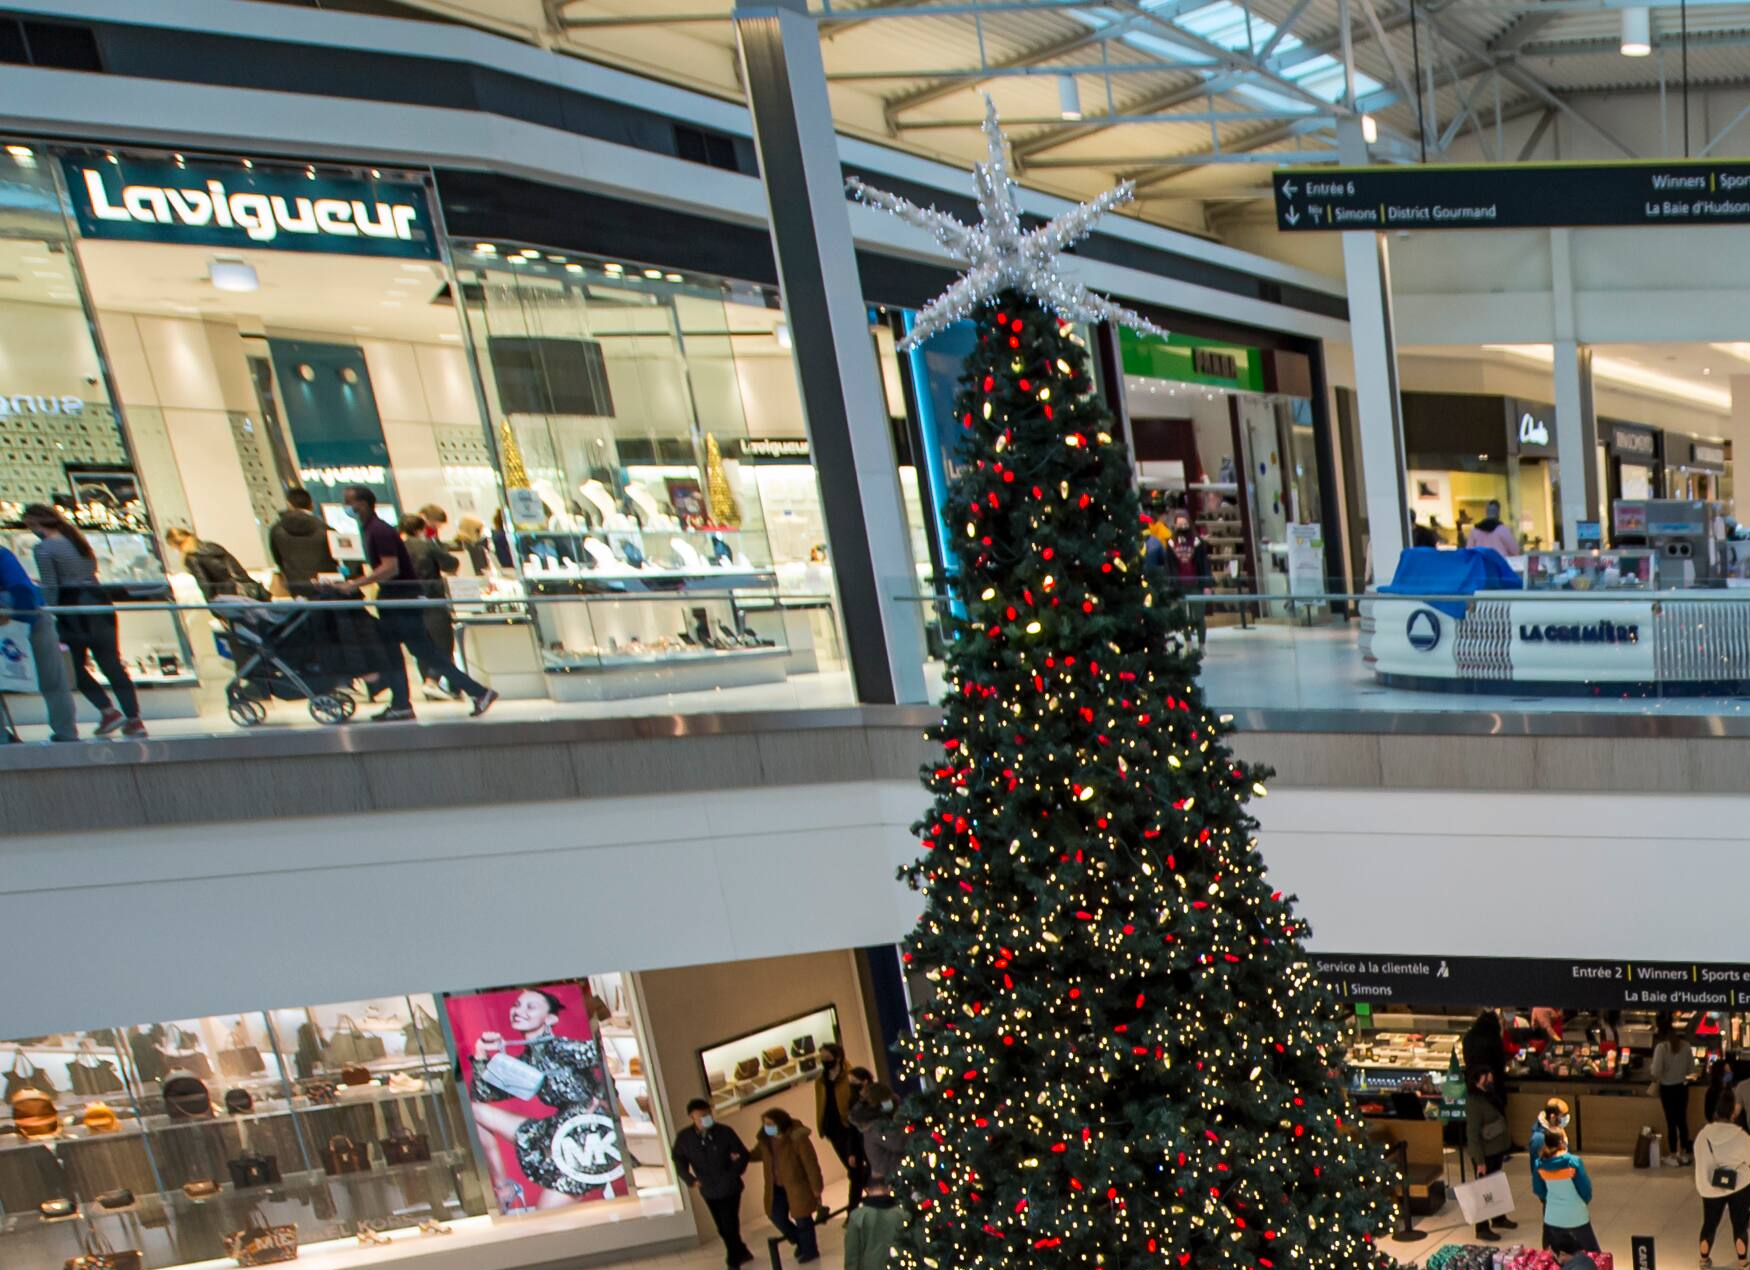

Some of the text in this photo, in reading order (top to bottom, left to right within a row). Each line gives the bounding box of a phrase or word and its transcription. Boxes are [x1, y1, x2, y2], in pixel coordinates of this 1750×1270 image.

[1306, 181, 1355, 196] Entrée 6
[1652, 174, 1706, 189] Winners
[82, 169, 417, 242] Lavigueur
[1335, 204, 1496, 222] Simons District Gourmand
[1646, 202, 1660, 216] La
[1663, 200, 1689, 215] Baie
[1692, 199, 1750, 215] d'Hudson
[1316, 960, 1430, 975] Service à la clientèle
[1572, 966, 1612, 979] Entrée
[1615, 966, 1623, 979] 2
[1637, 967, 1688, 980] Winners
[1701, 968, 1740, 982] Sports
[1350, 983, 1393, 996] Simons
[1625, 990, 1639, 1002] La
[1641, 990, 1668, 1003] Baie
[1670, 990, 1727, 1004] d'Hudson
